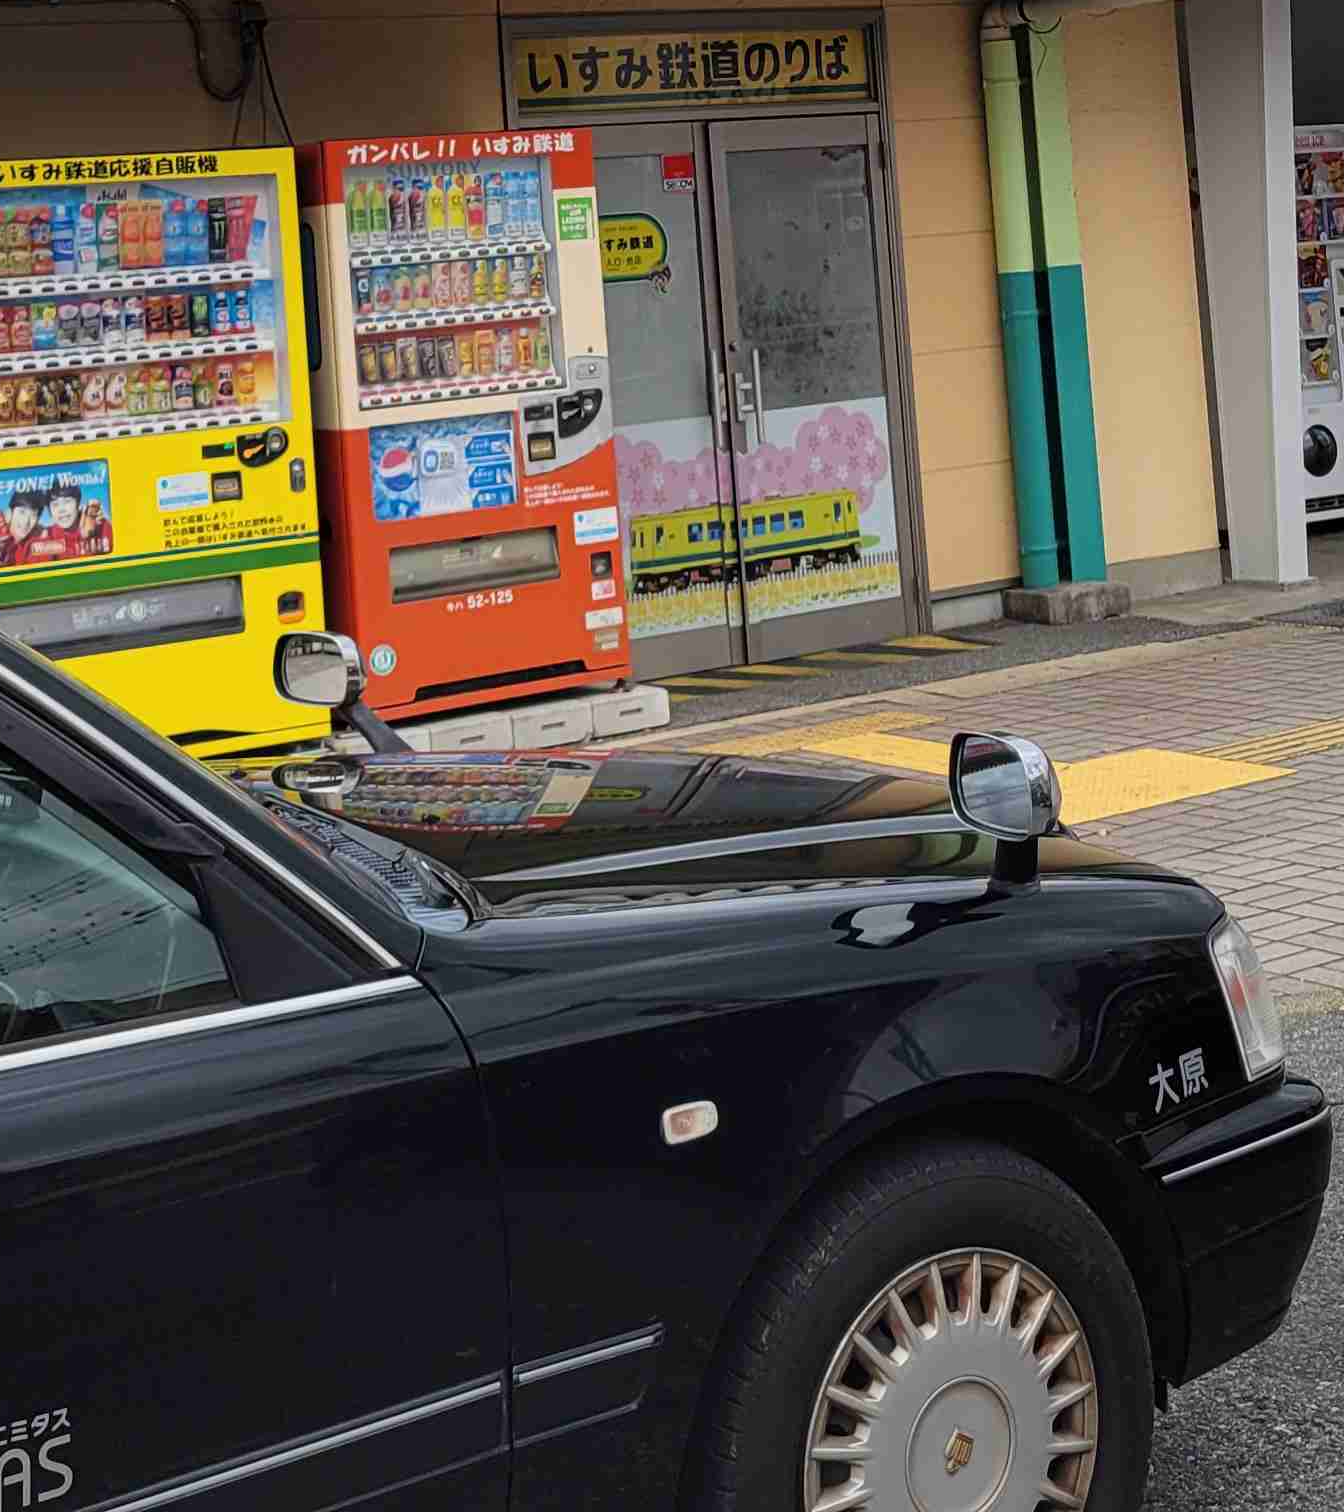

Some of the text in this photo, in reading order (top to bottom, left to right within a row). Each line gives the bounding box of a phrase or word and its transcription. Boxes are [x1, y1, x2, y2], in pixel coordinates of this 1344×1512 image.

[527, 34, 849, 94] いすみ鉄道のりば
[471, 132, 576, 156] いすみ鉄道
[599, 234, 654, 252] すみ鉄道
[1148, 1047, 1209, 1114] 大原
